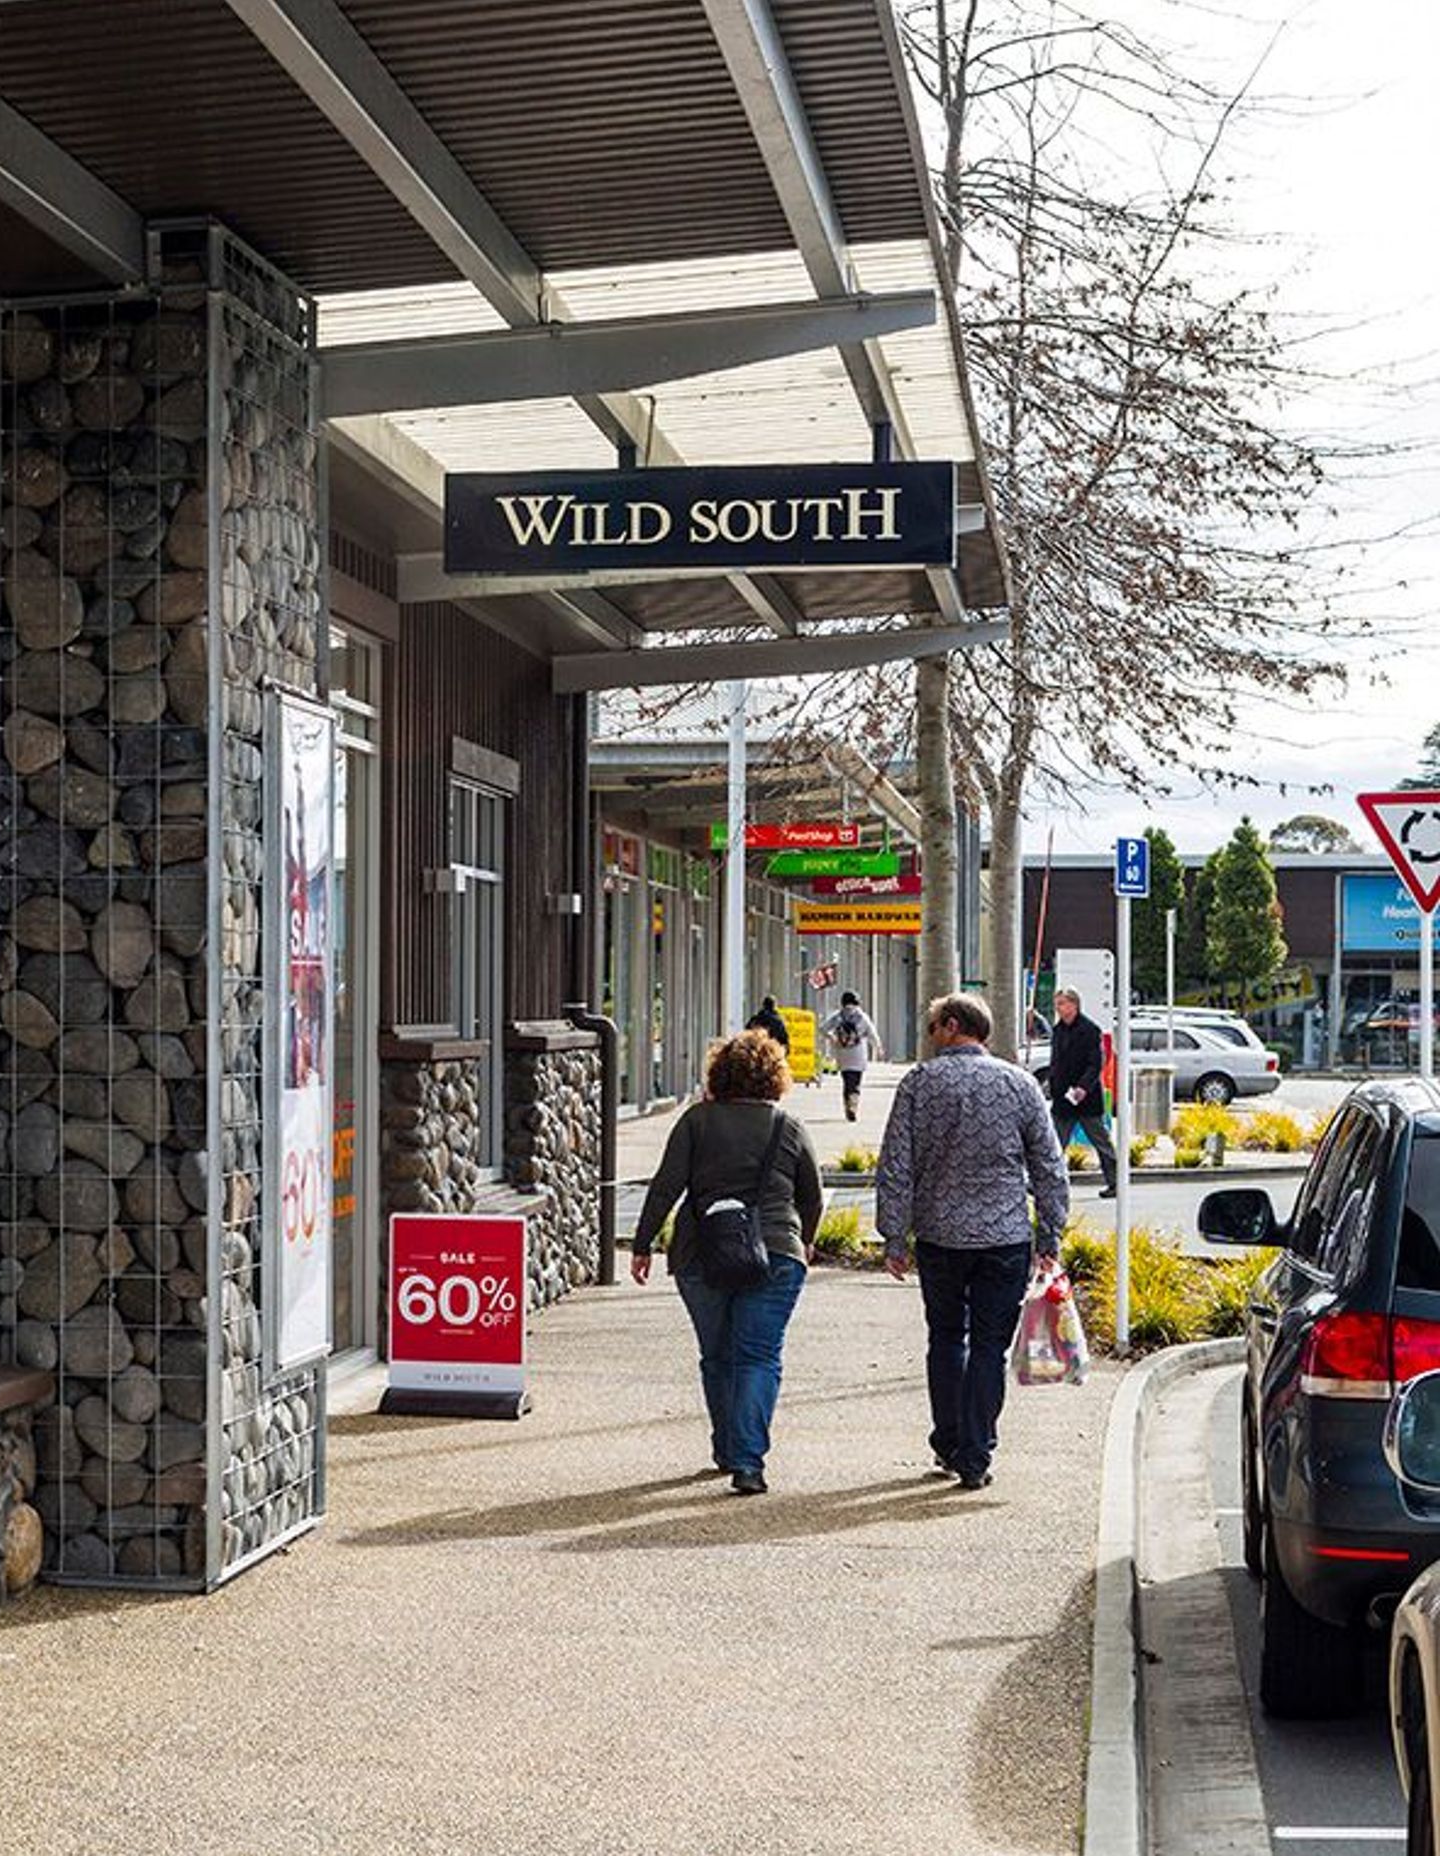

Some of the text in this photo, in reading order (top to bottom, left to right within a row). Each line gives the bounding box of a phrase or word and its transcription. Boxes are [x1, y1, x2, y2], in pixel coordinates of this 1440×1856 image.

[496, 487, 903, 546] WILD SOUTH
[1127, 841, 1139, 862] P
[856, 912, 921, 922] HARDWAR
[439, 1251, 476, 1265] SALE
[398, 1273, 517, 1326] 60%
[479, 1311, 516, 1328] OFF
